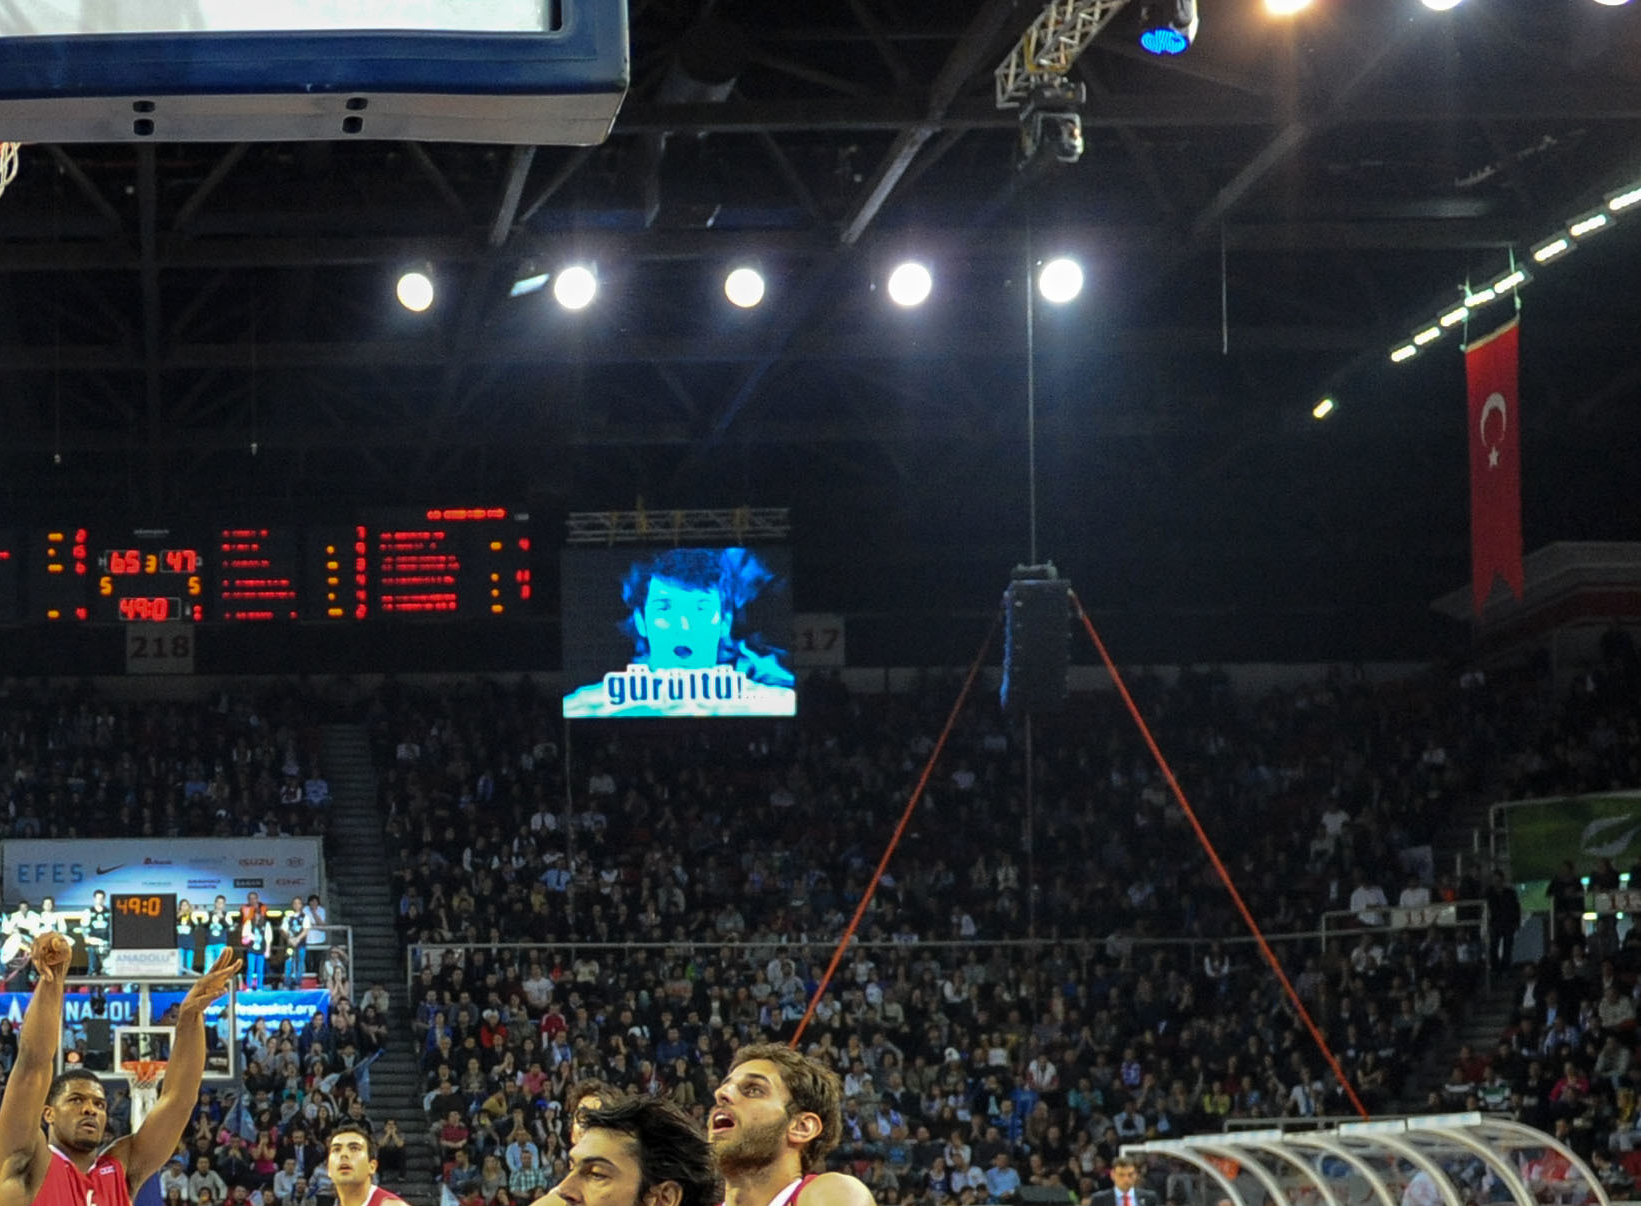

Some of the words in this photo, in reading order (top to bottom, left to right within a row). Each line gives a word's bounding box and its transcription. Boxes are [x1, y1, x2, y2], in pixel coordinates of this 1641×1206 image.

[110, 549, 140, 574] 65
[145, 554, 157, 573] 3
[166, 549, 196, 573] 47
[131, 635, 191, 659] 218
[18, 864, 83, 883] EFES
[116, 897, 161, 916] 49:0
